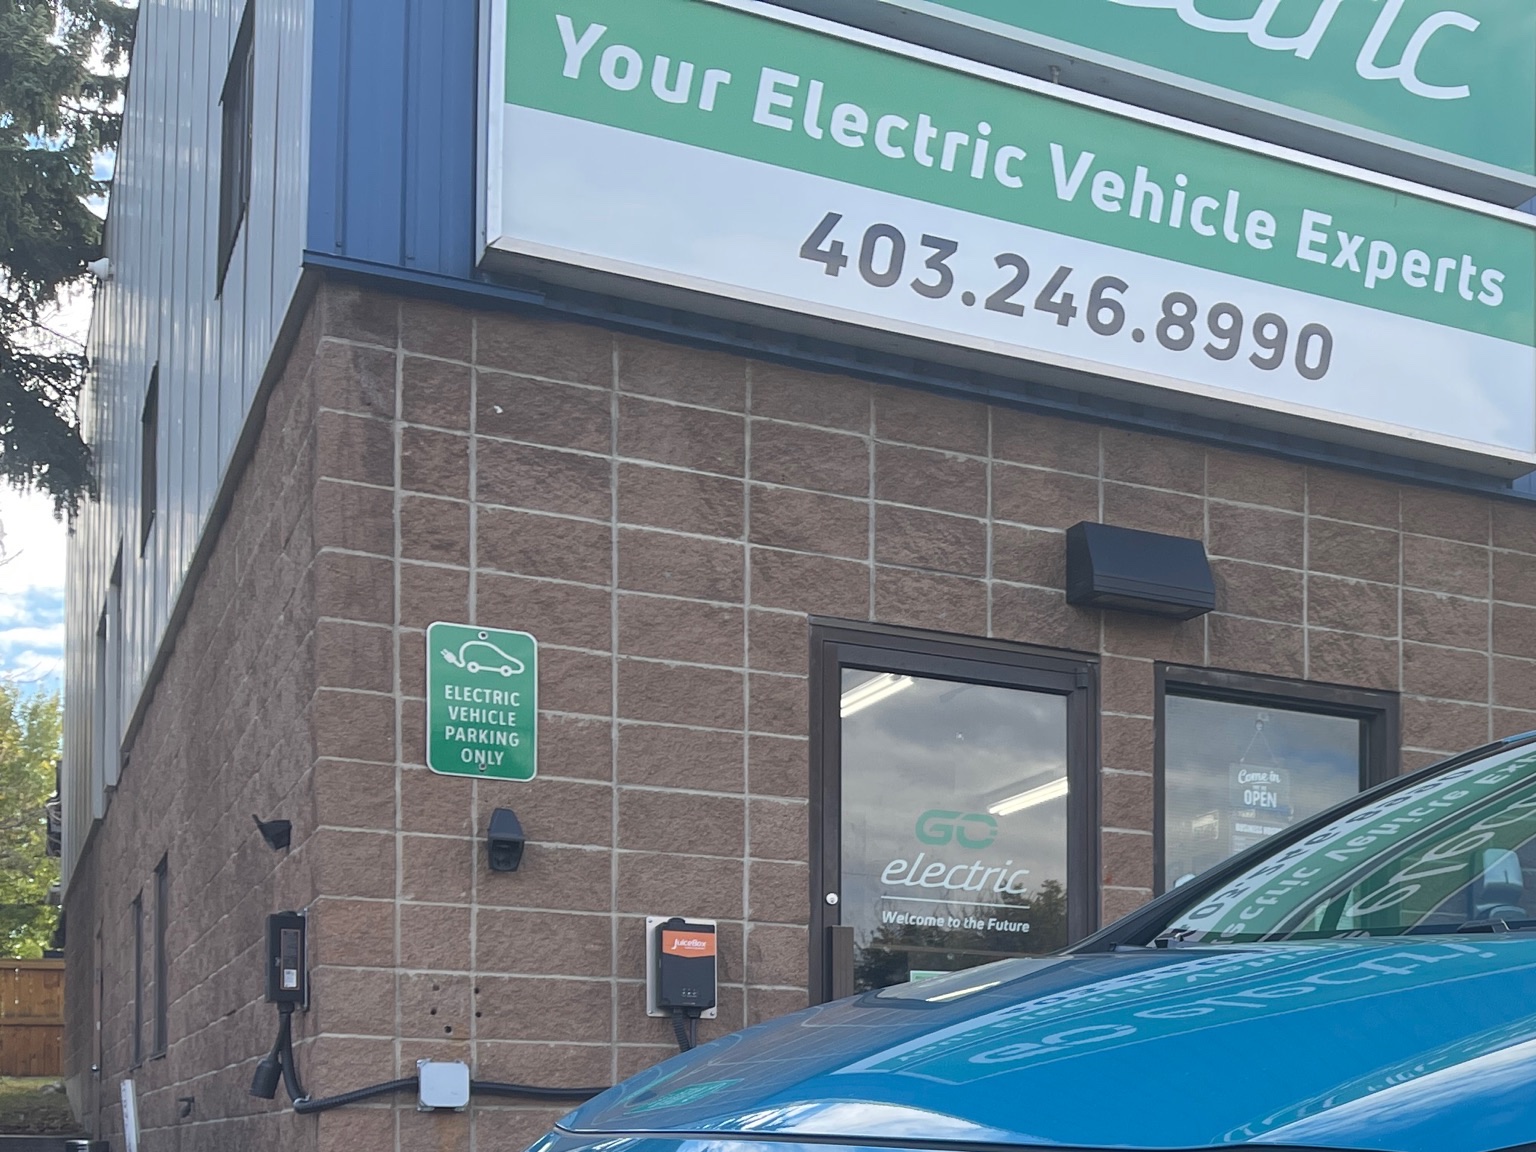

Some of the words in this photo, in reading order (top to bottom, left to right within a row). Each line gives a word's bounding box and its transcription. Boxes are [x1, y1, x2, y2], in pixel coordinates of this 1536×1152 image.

[555, 16, 731, 114] Your
[752, 70, 1027, 190] Electric
[1048, 142, 1275, 251] Vehicle
[1297, 209, 1506, 309] Experts
[798, 210, 1334, 382] 403.246.8990
[444, 684, 520, 707] ELECTRIC
[448, 705, 517, 727] VEHICLE
[444, 726, 520, 747] PARKING
[461, 748, 504, 765] ONLY
[1238, 769, 1268, 784] Come
[1267, 771, 1281, 784] in
[1244, 789, 1277, 808] OPEN
[915, 809, 998, 849] GO
[881, 852, 1030, 894] electric
[882, 911, 944, 927] Welcome
[948, 917, 961, 928] to
[964, 917, 985, 930] the
[987, 918, 1030, 933] Future
[671, 938, 707, 949] JuiceBox
